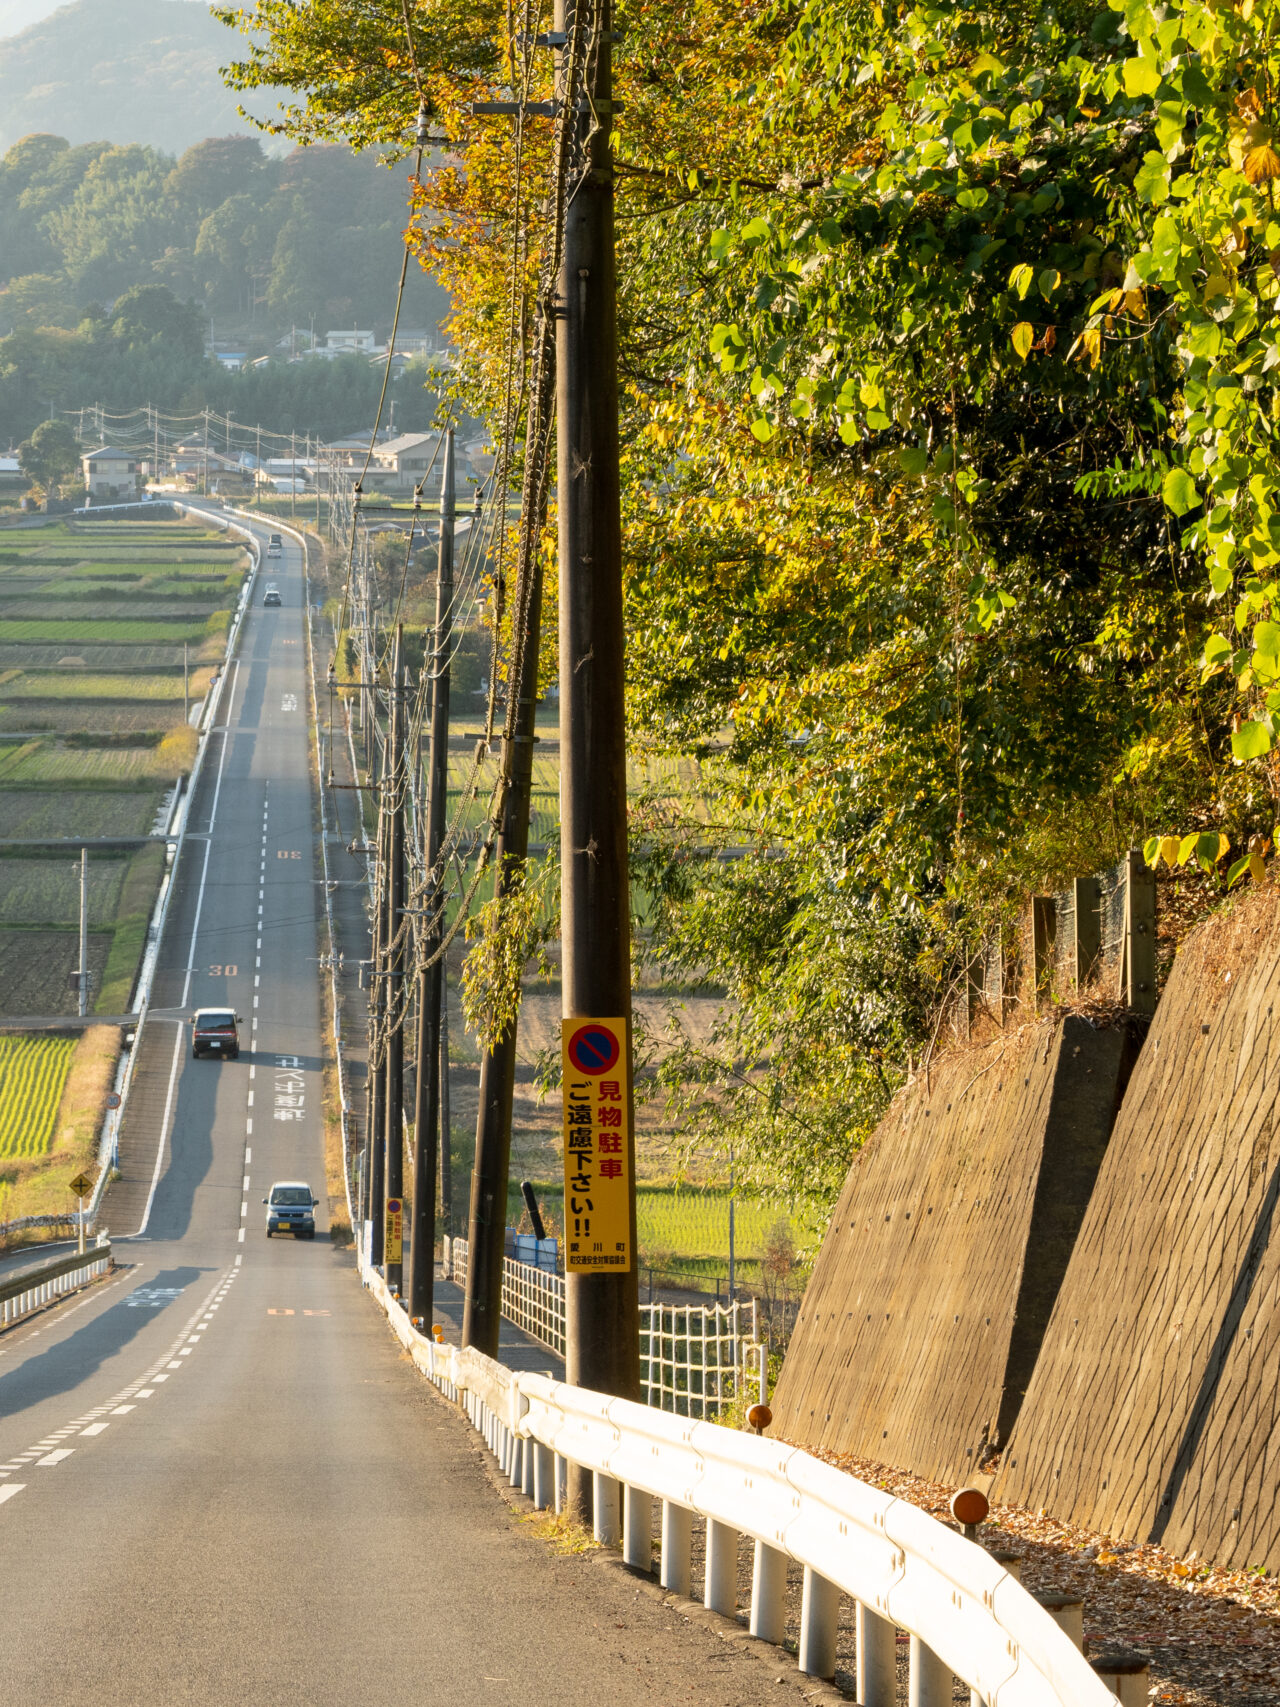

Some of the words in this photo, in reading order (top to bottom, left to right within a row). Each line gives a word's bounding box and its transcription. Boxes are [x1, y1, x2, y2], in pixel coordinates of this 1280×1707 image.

[208, 964, 238, 977] 30
[568, 1080, 594, 1237] ご遠慮下さい!!
[597, 1080, 623, 1180] 見物駐車
